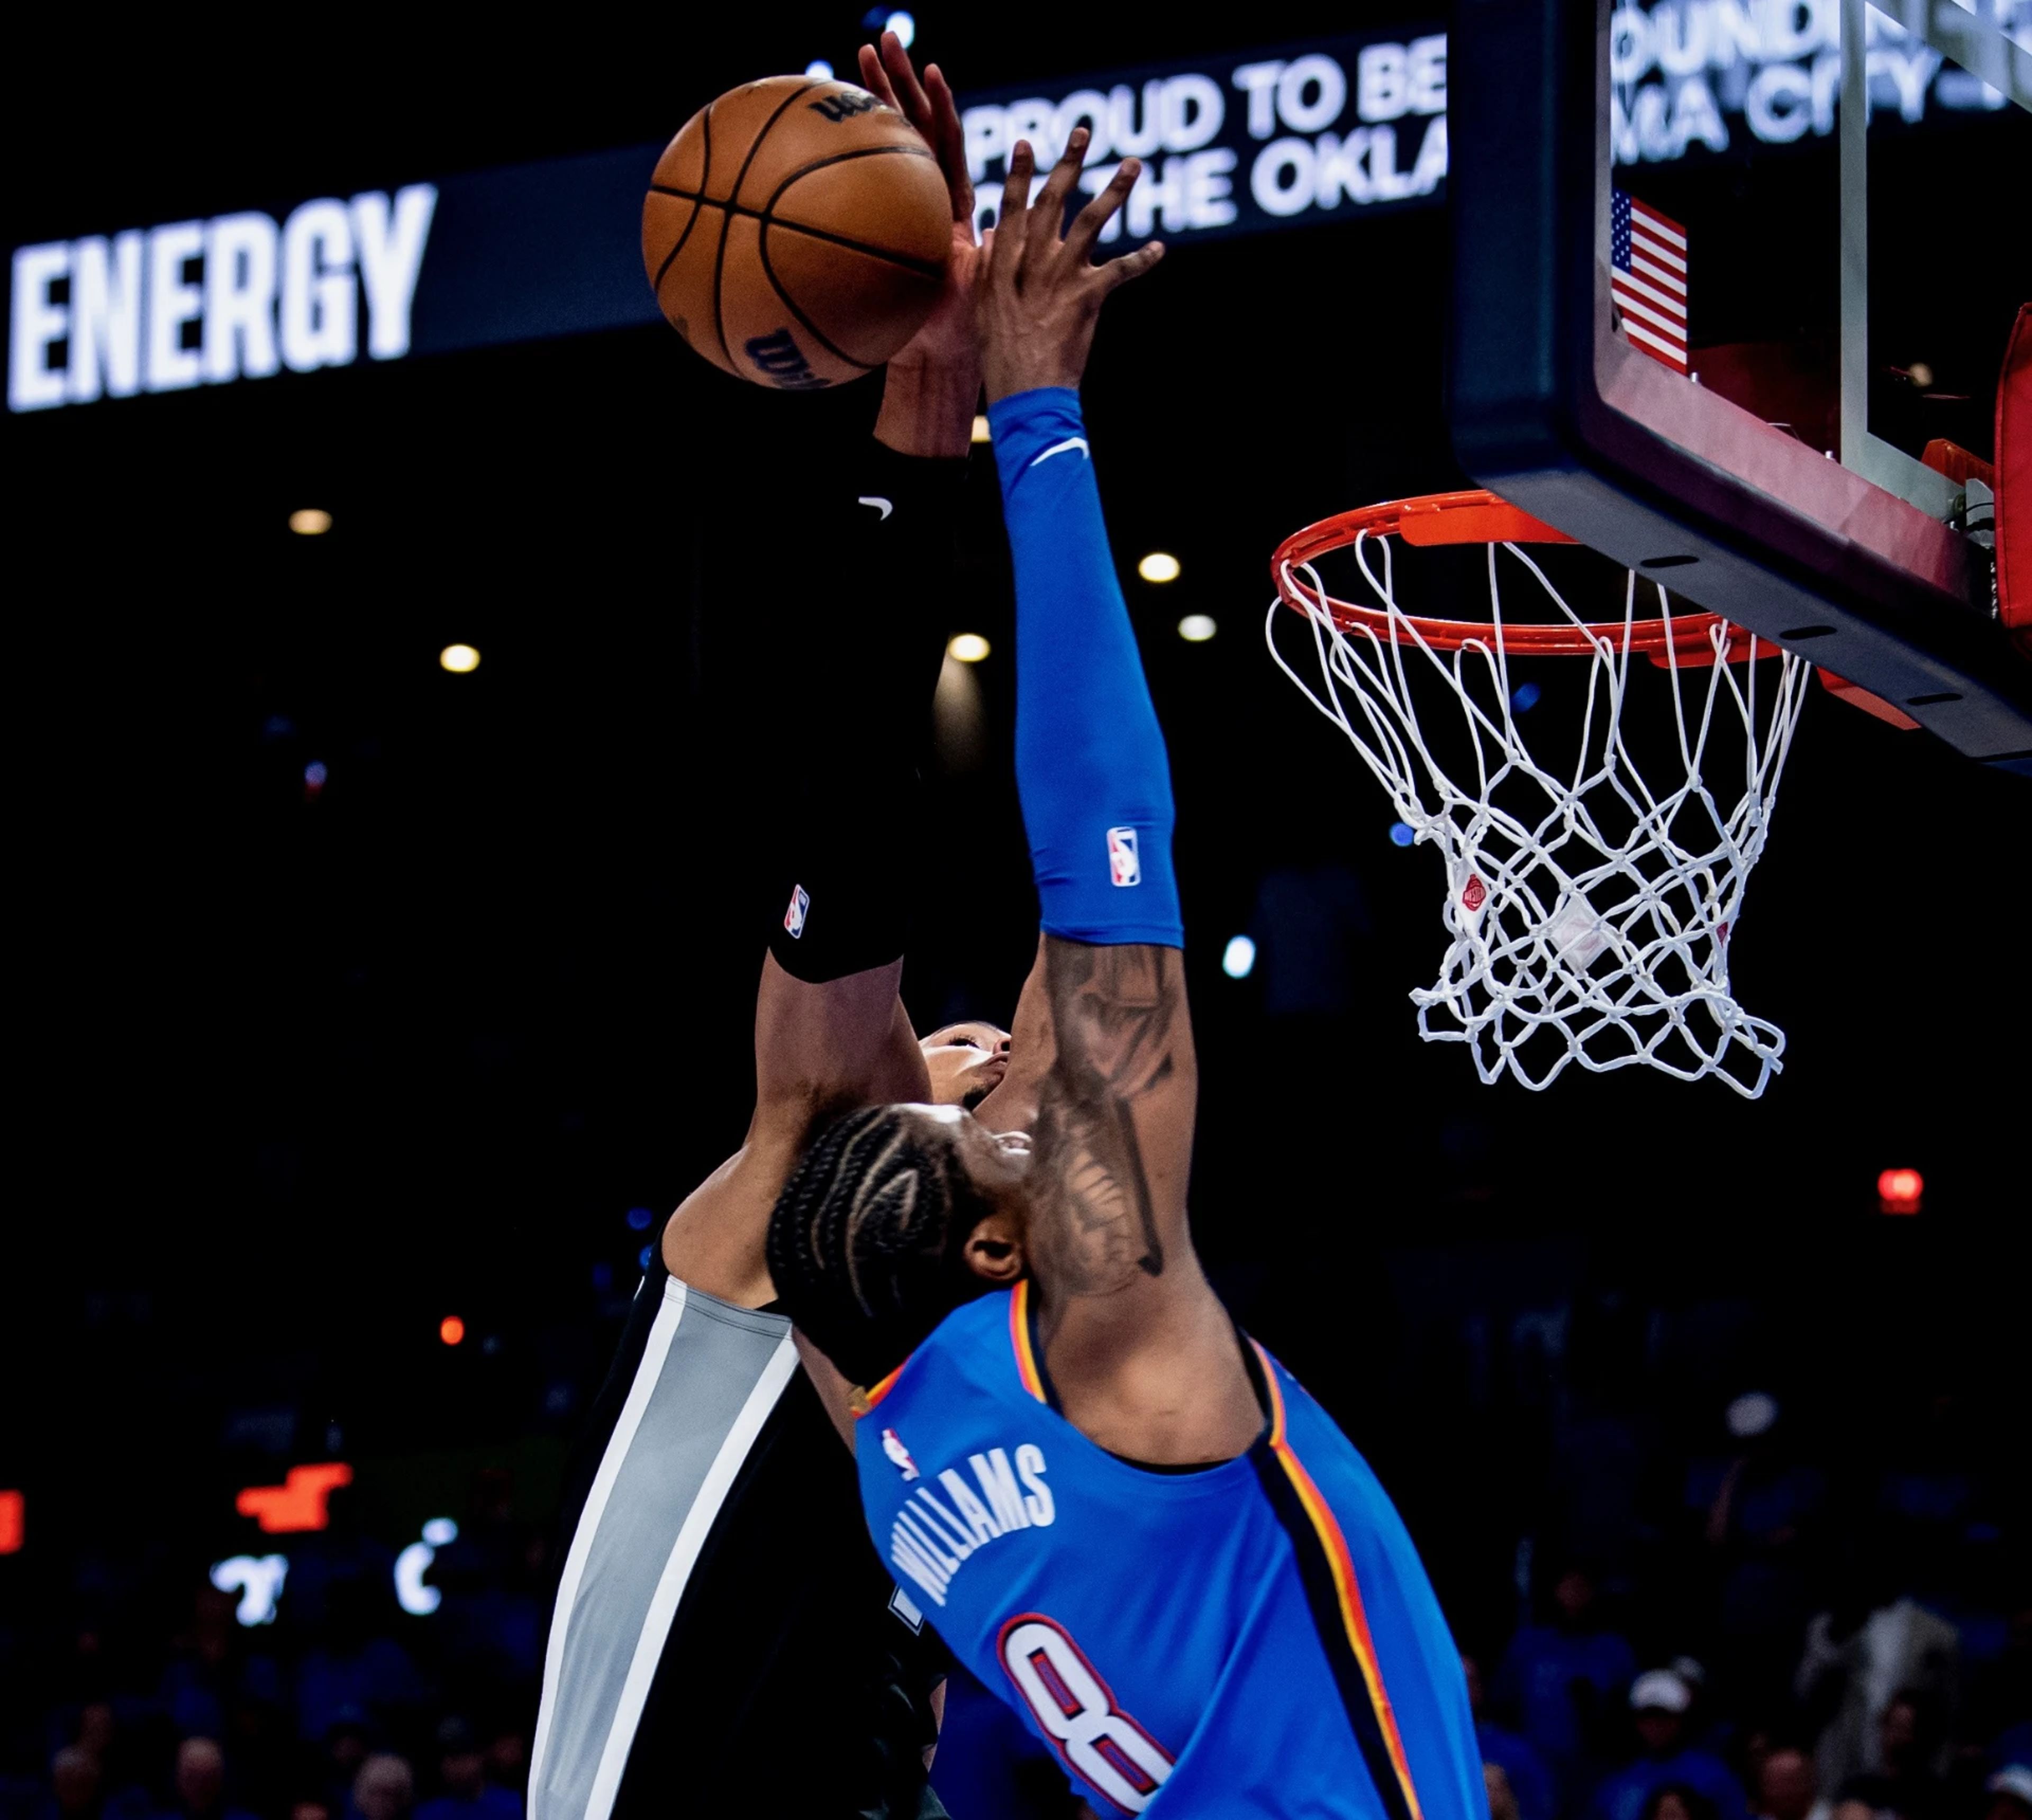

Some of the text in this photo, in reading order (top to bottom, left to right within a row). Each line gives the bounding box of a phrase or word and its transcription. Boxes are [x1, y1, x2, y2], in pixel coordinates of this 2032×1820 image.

[961, 74, 1224, 184] PROUD
[1231, 53, 1347, 140] TO
[1357, 33, 1447, 123] BE
[1077, 147, 1239, 243] THE
[7, 182, 439, 414] ENERGY
[891, 1443, 1056, 1607] WILLIAMS
[997, 1612, 1178, 1818] 8
